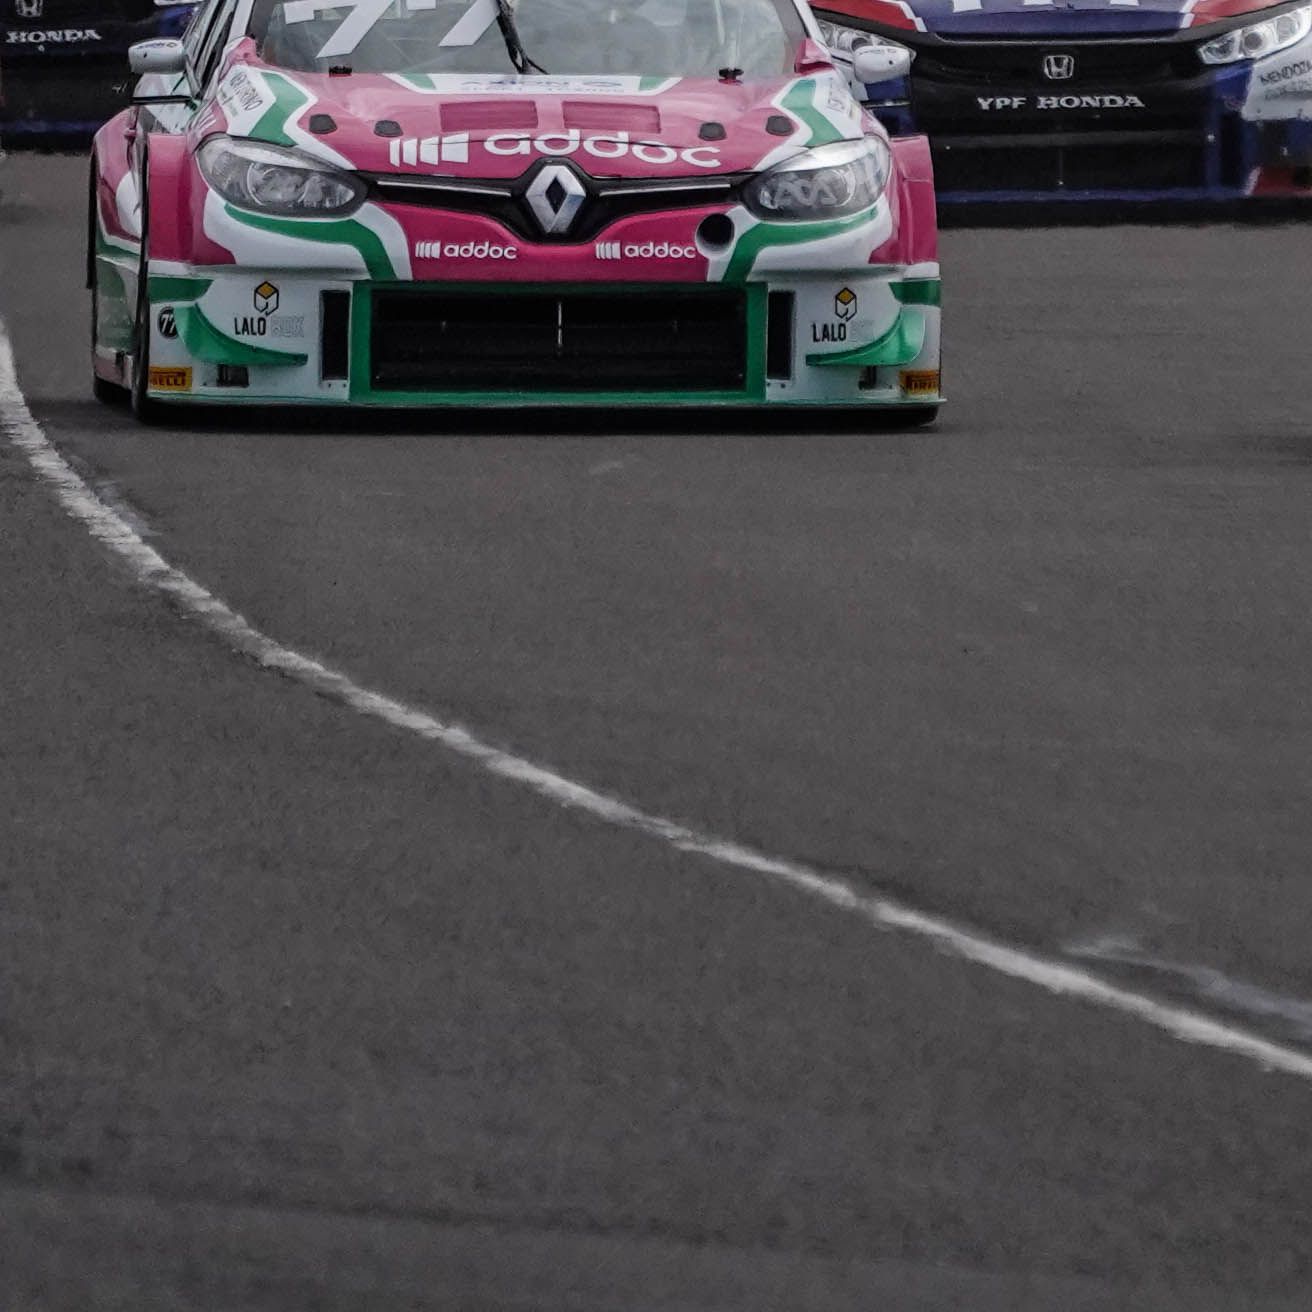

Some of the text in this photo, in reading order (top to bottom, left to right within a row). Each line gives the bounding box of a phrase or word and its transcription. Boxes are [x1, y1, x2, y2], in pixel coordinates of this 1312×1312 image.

[6, 28, 102, 44] HONDA
[977, 95, 1146, 111] YPF HONDA
[483, 129, 722, 168] addoc
[444, 241, 518, 261] addoc
[624, 241, 697, 260] addoc
[234, 317, 267, 336] LALO
[811, 322, 847, 343] LALO
